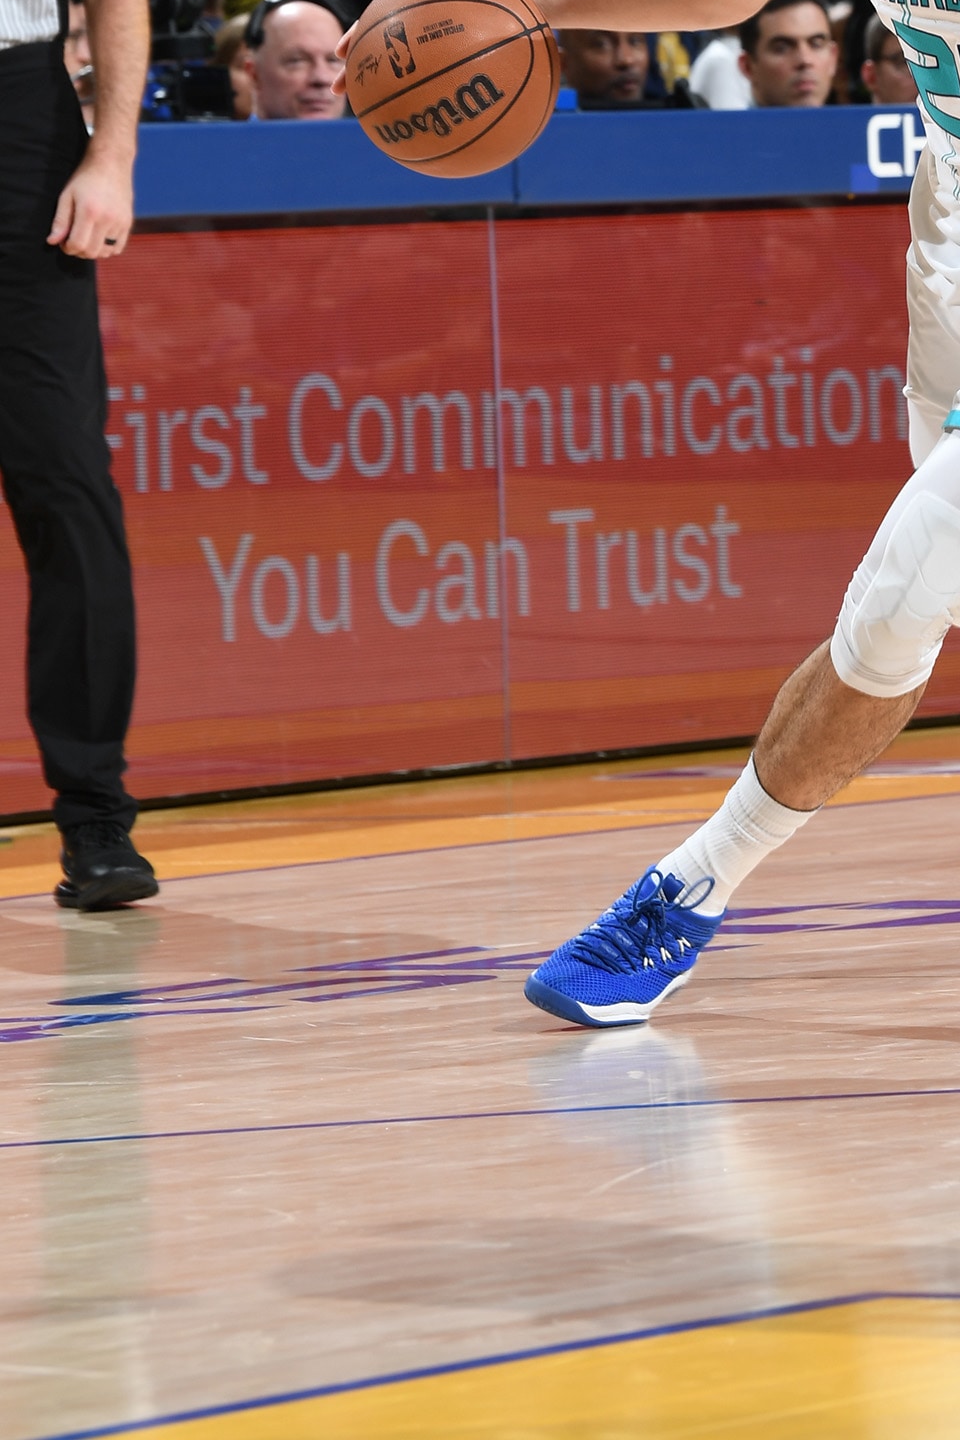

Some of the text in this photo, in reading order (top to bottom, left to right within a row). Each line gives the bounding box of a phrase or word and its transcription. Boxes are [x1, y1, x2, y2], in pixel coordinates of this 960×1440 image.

[375, 73, 505, 143] Wilson
[199, 505, 743, 642] You Can Trust
